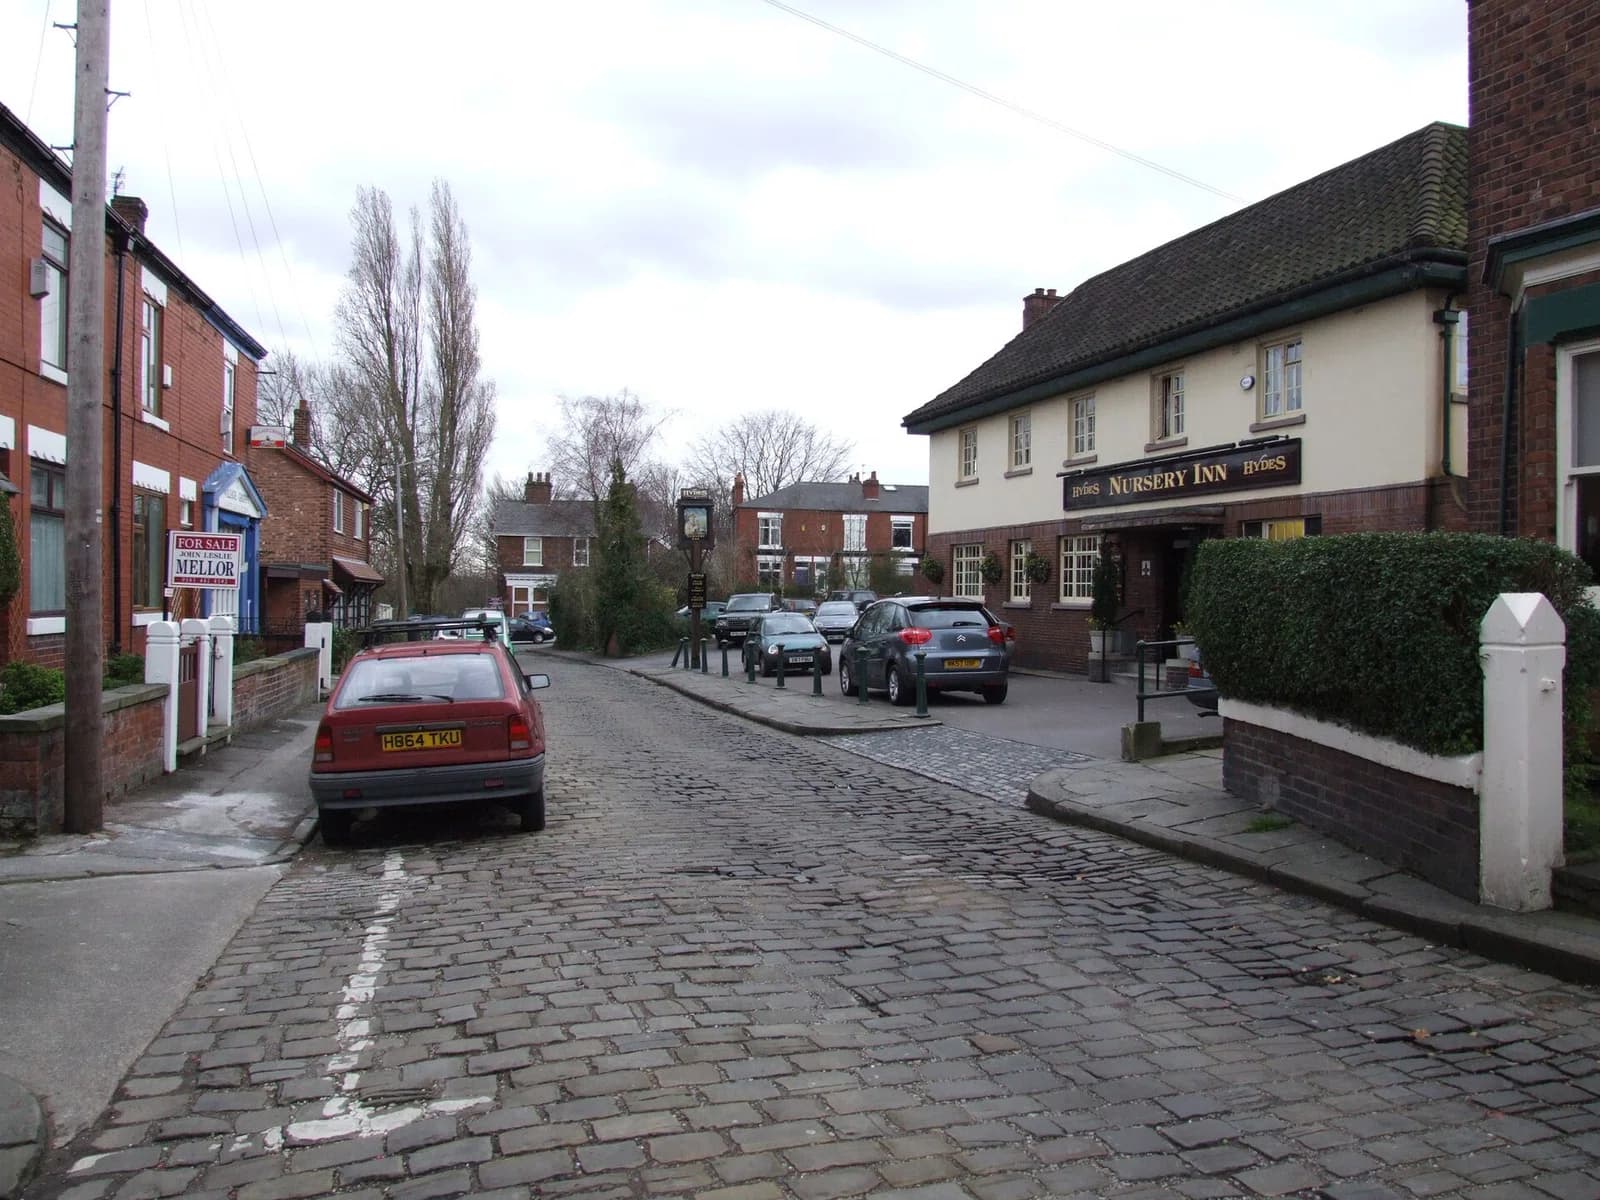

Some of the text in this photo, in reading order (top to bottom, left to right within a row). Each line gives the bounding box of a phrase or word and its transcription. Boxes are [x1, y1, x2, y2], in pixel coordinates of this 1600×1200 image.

[1243, 454, 1287, 475] HYDES
[1109, 463, 1227, 496] NURSERY INN
[1072, 481, 1100, 498] HYDES
[177, 537, 236, 550] FOR SALE
[203, 551, 233, 560] LESLIE
[176, 559, 234, 577] MELLOR
[429, 731, 460, 745] TKU
